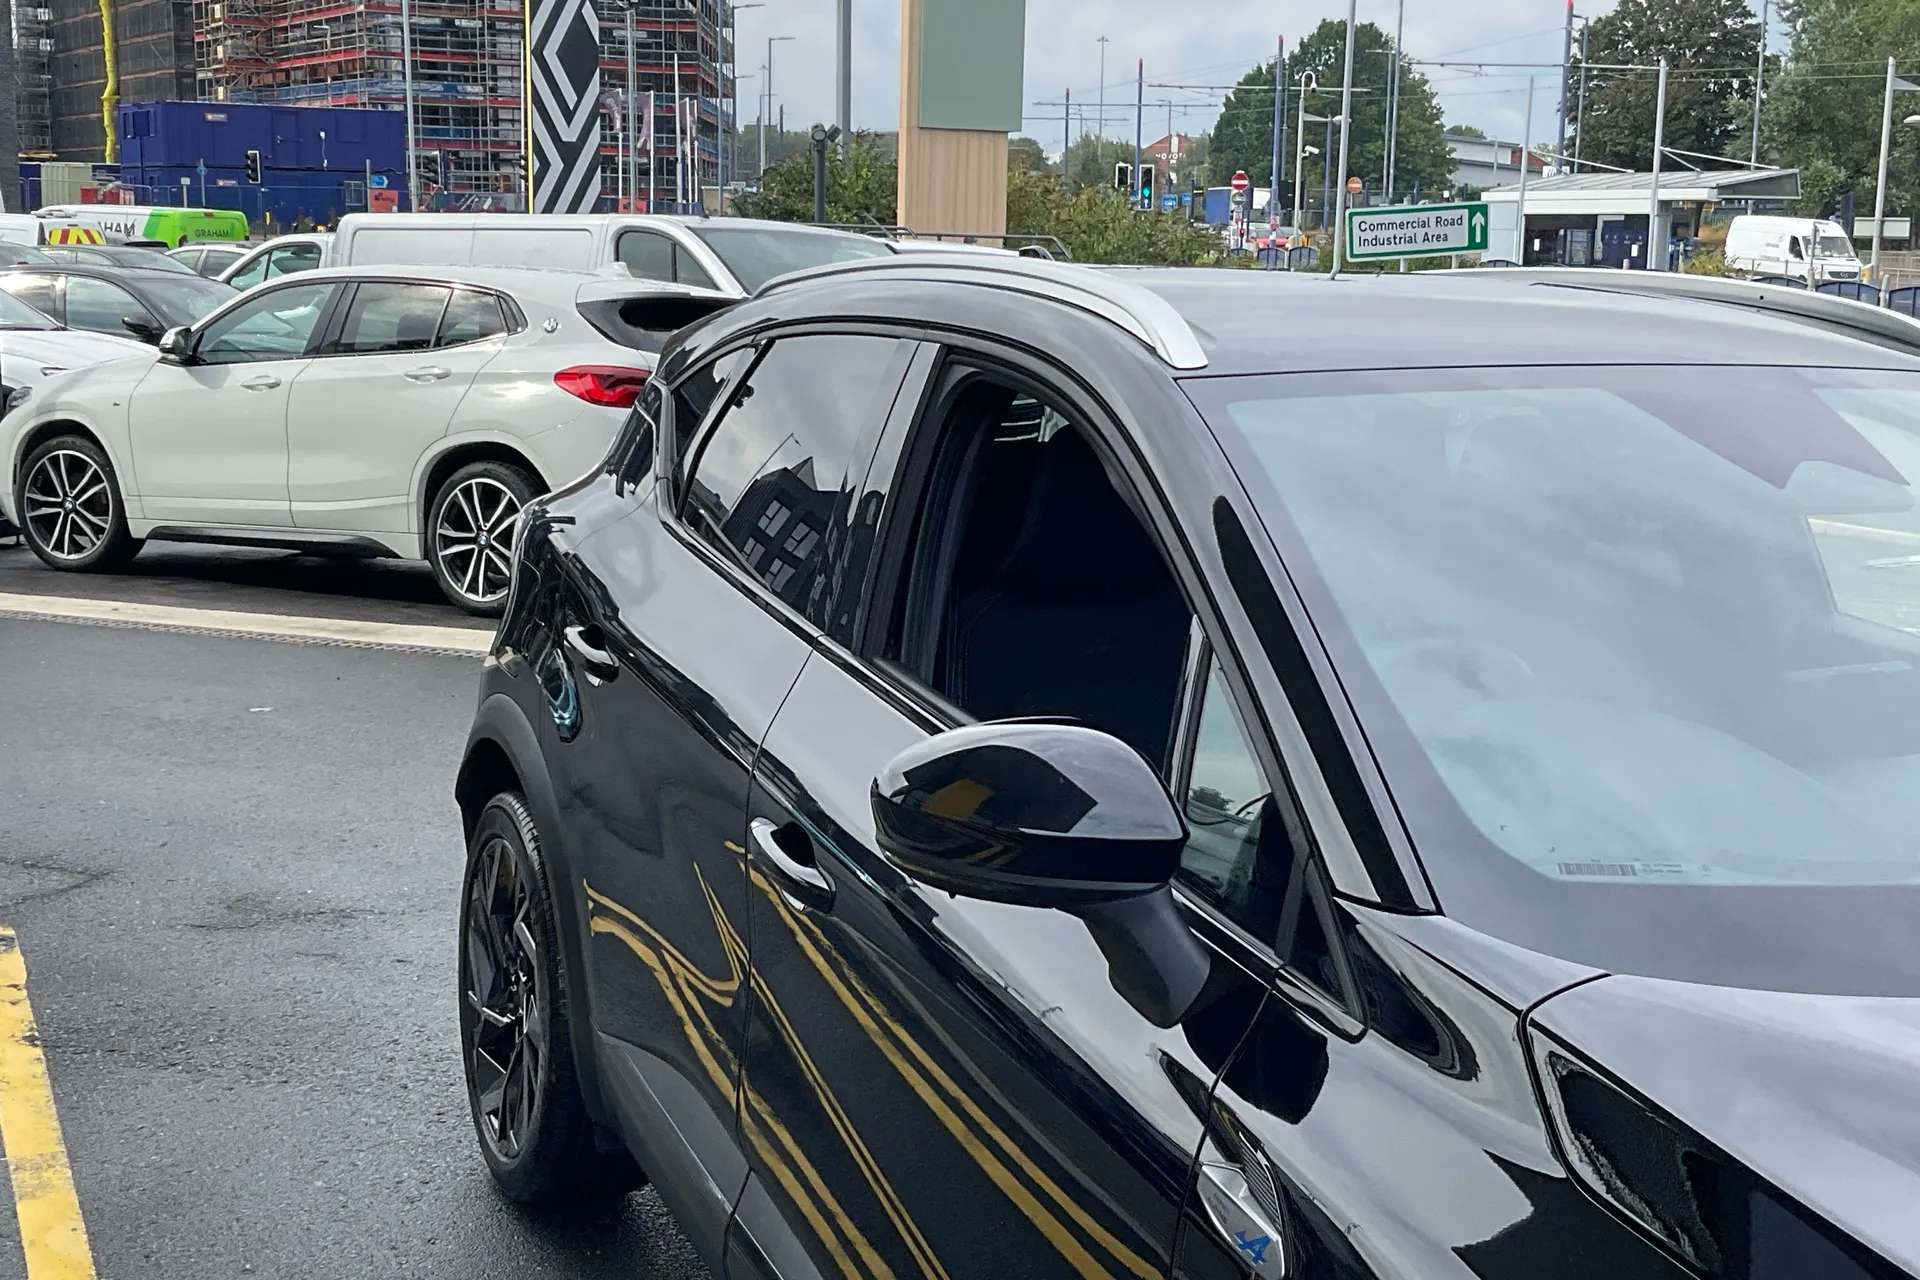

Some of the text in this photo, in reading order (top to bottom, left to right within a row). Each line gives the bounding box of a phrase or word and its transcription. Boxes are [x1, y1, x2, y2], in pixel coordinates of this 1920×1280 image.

[98, 221, 135, 234] HAM
[1359, 214, 1463, 232] Commercial Road
[194, 229, 230, 239] GRAHAM
[1359, 231, 1448, 247] Industrial Area
